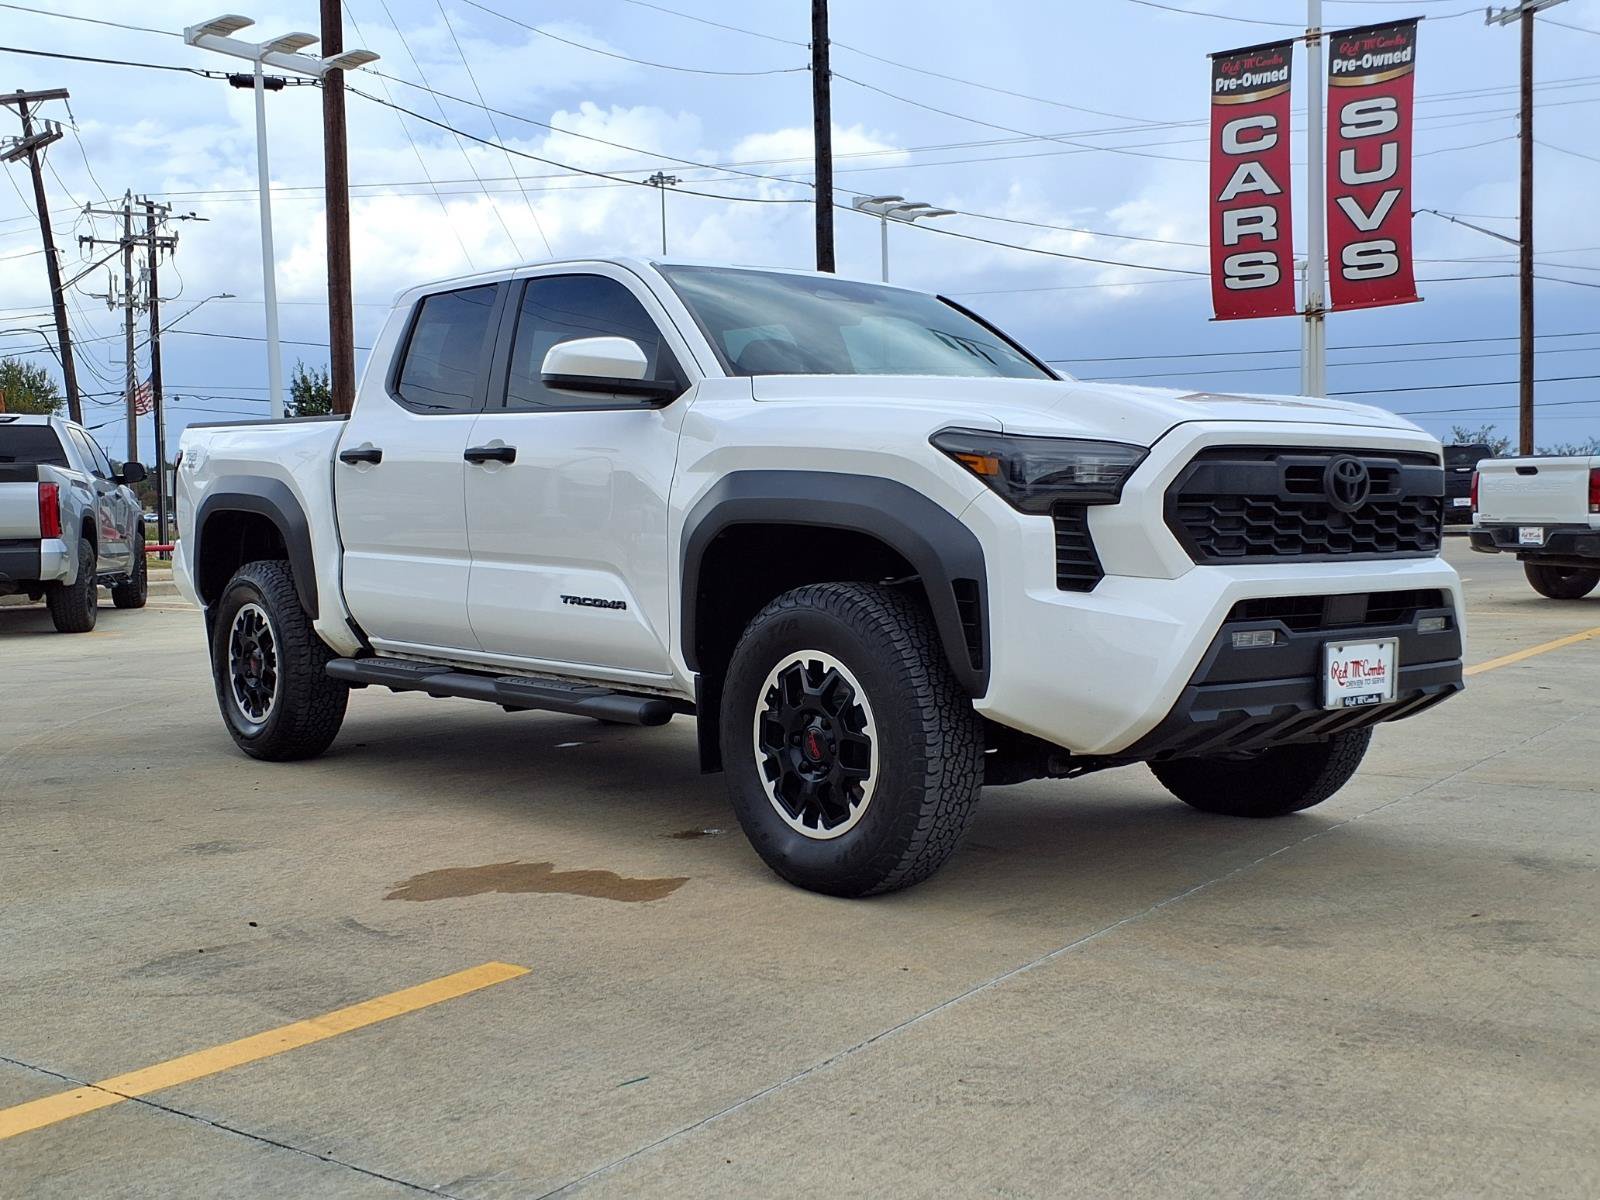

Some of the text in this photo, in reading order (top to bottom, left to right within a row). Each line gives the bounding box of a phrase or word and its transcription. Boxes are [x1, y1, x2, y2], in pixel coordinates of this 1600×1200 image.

[1332, 46, 1412, 74] Pre-Owned
[1215, 65, 1288, 92] Pre-Owned
[1217, 114, 1283, 290] CARS
[1334, 96, 1403, 281] SUVS
[560, 595, 626, 610] TACOMA
[1331, 659, 1385, 686] Red McCombs
